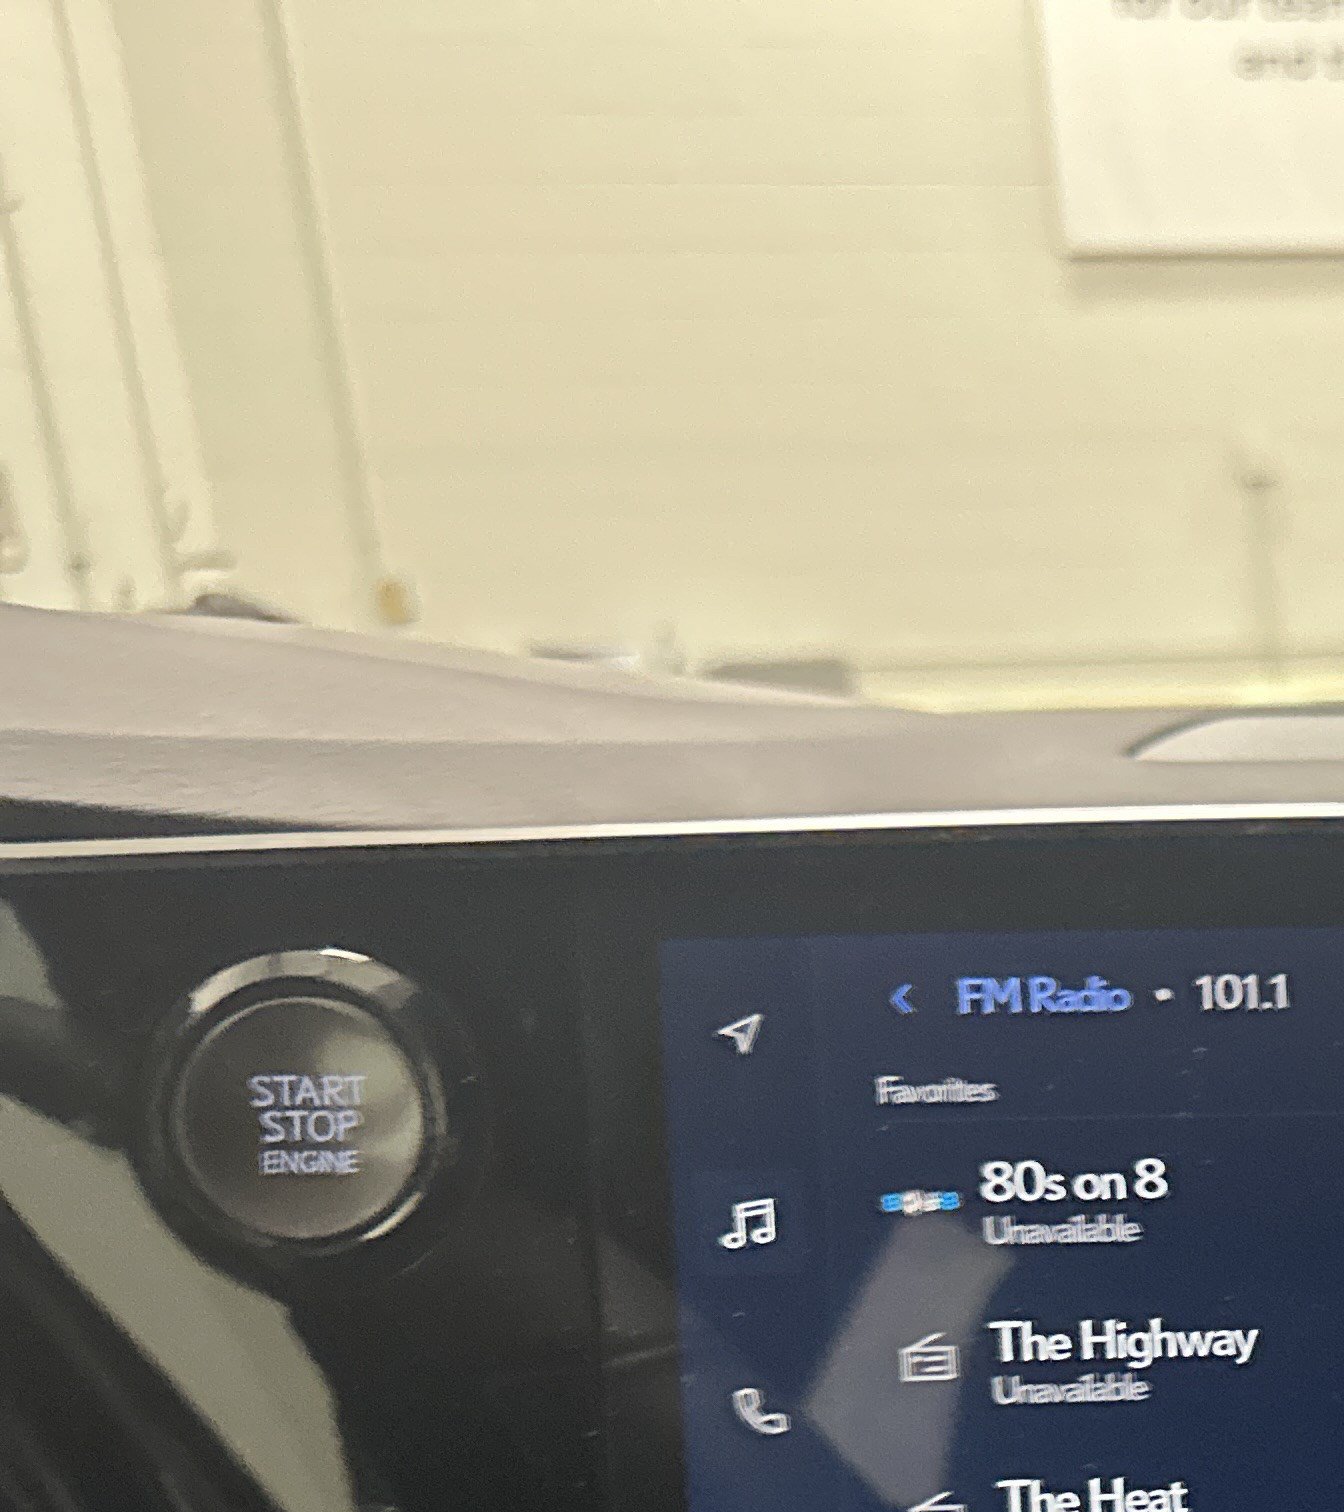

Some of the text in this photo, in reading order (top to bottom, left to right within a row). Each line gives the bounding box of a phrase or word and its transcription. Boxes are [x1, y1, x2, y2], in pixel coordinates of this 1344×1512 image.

[955, 974, 1291, 1015] FM Radio 101.1
[248, 1074, 365, 1108] START
[875, 1075, 998, 1106] Favorites
[258, 1109, 362, 1143] STOP
[258, 1150, 360, 1176] ENGINE
[979, 1158, 1169, 1202] 80s on 8
[982, 1214, 1144, 1247] Unavailable
[988, 1319, 1259, 1370] The Highway
[991, 1374, 1152, 1406] Unavailable
